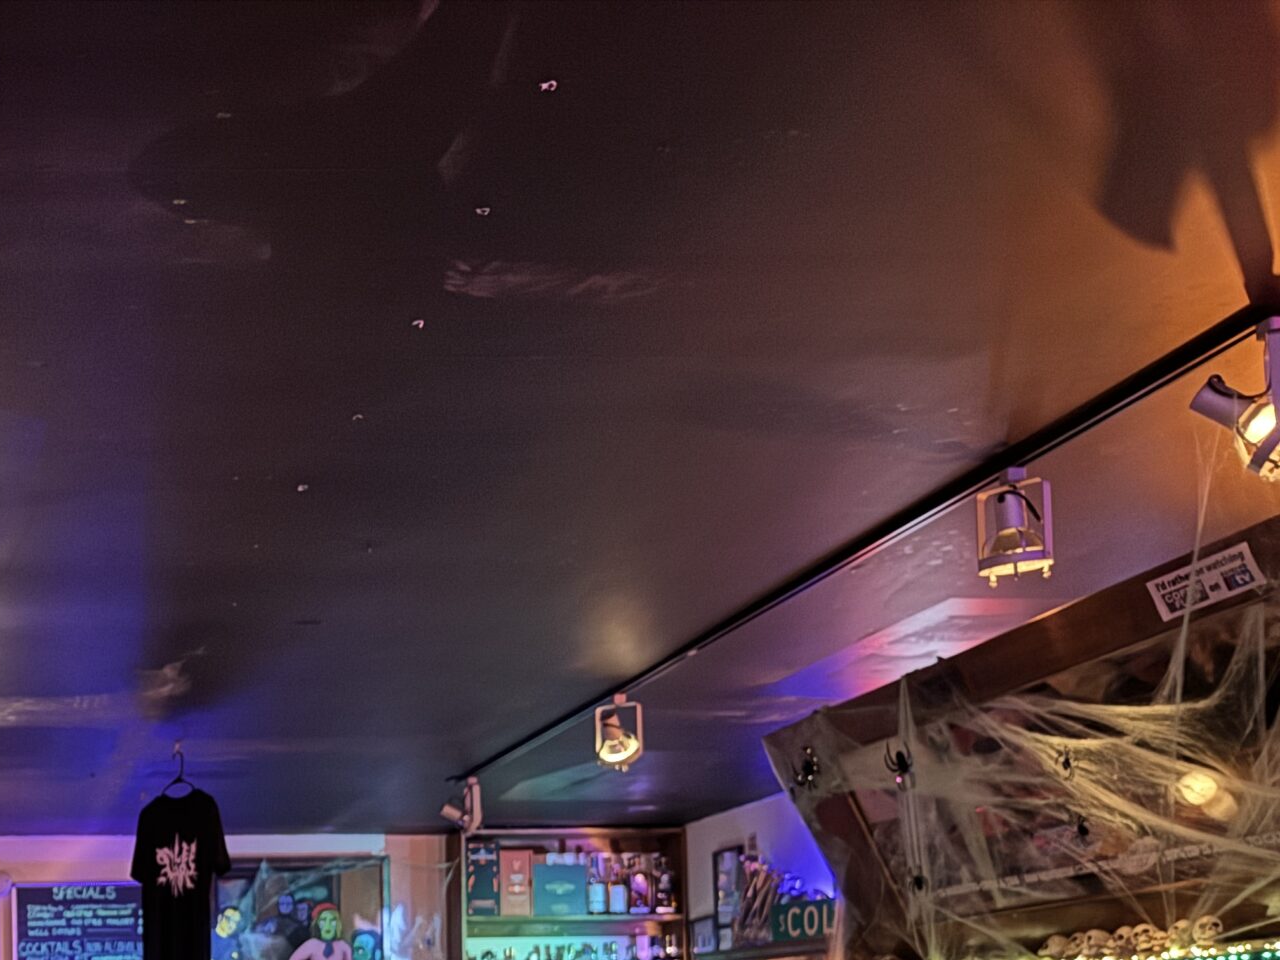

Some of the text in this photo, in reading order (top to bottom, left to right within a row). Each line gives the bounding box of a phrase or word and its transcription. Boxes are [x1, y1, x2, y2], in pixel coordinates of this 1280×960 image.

[1154, 580, 1167, 593] I'd
[1206, 551, 1245, 573] watching
[52, 885, 116, 900] SPECIALS
[19, 940, 82, 957] COCKTAILS
